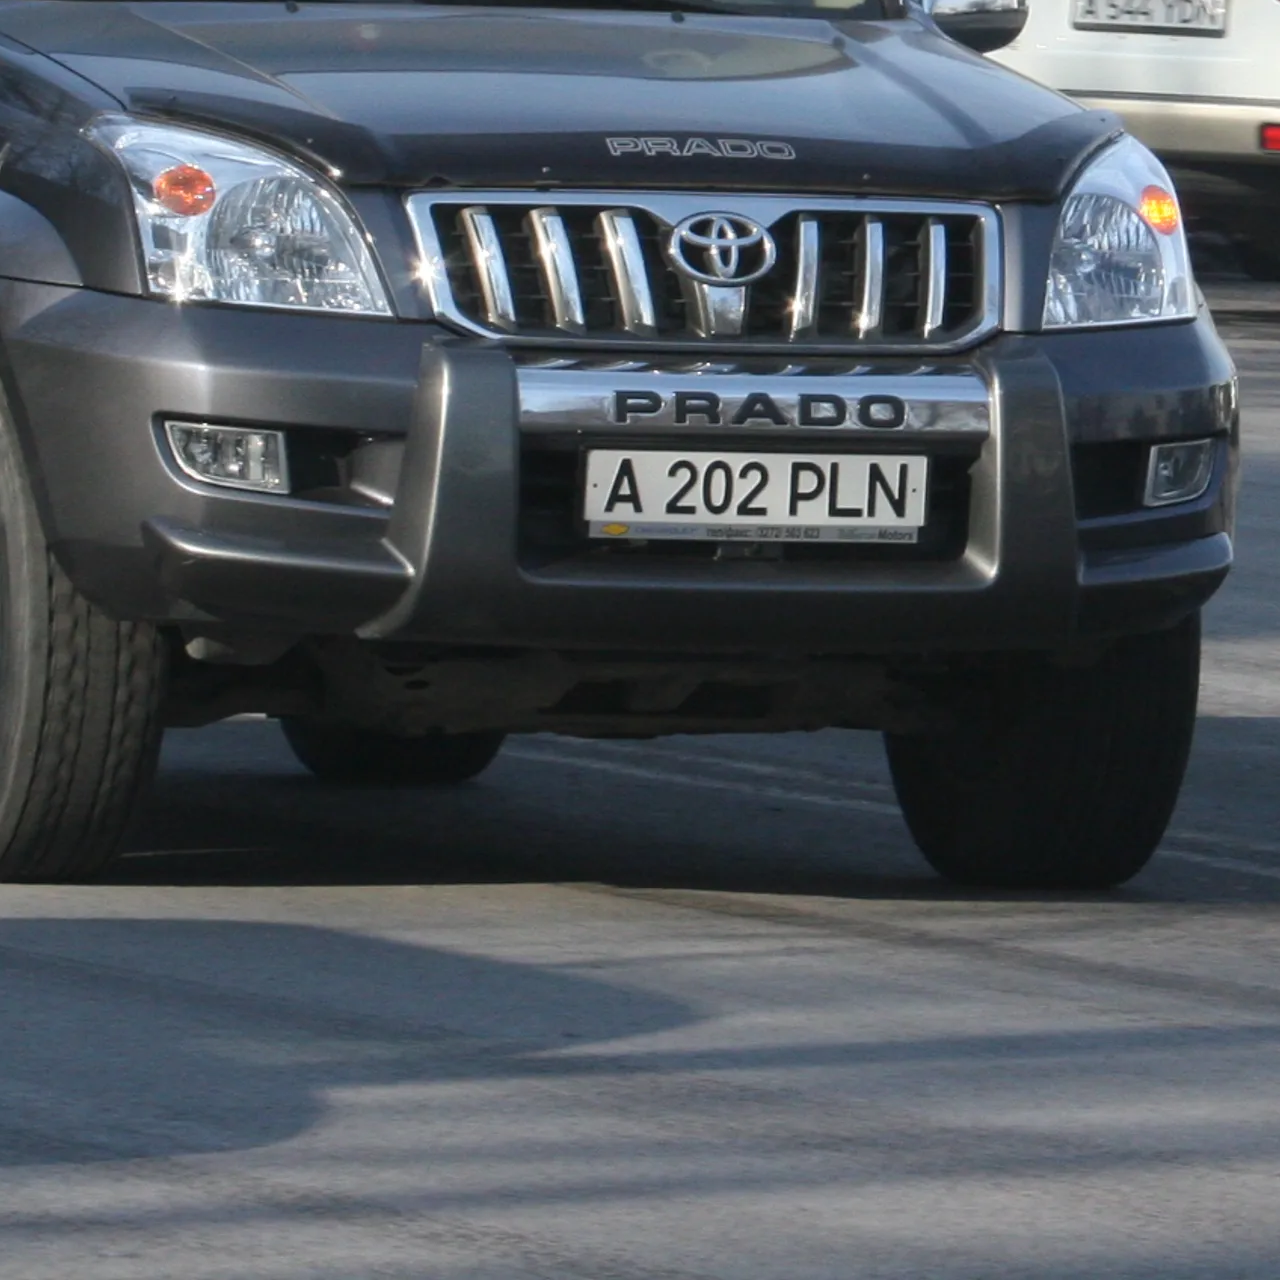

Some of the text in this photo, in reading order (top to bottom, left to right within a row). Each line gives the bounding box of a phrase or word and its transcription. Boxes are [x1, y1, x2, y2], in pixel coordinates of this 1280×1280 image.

[606, 137, 796, 159] PRADO
[613, 390, 908, 429] PRADO
[604, 458, 909, 518] A 202 PLN
